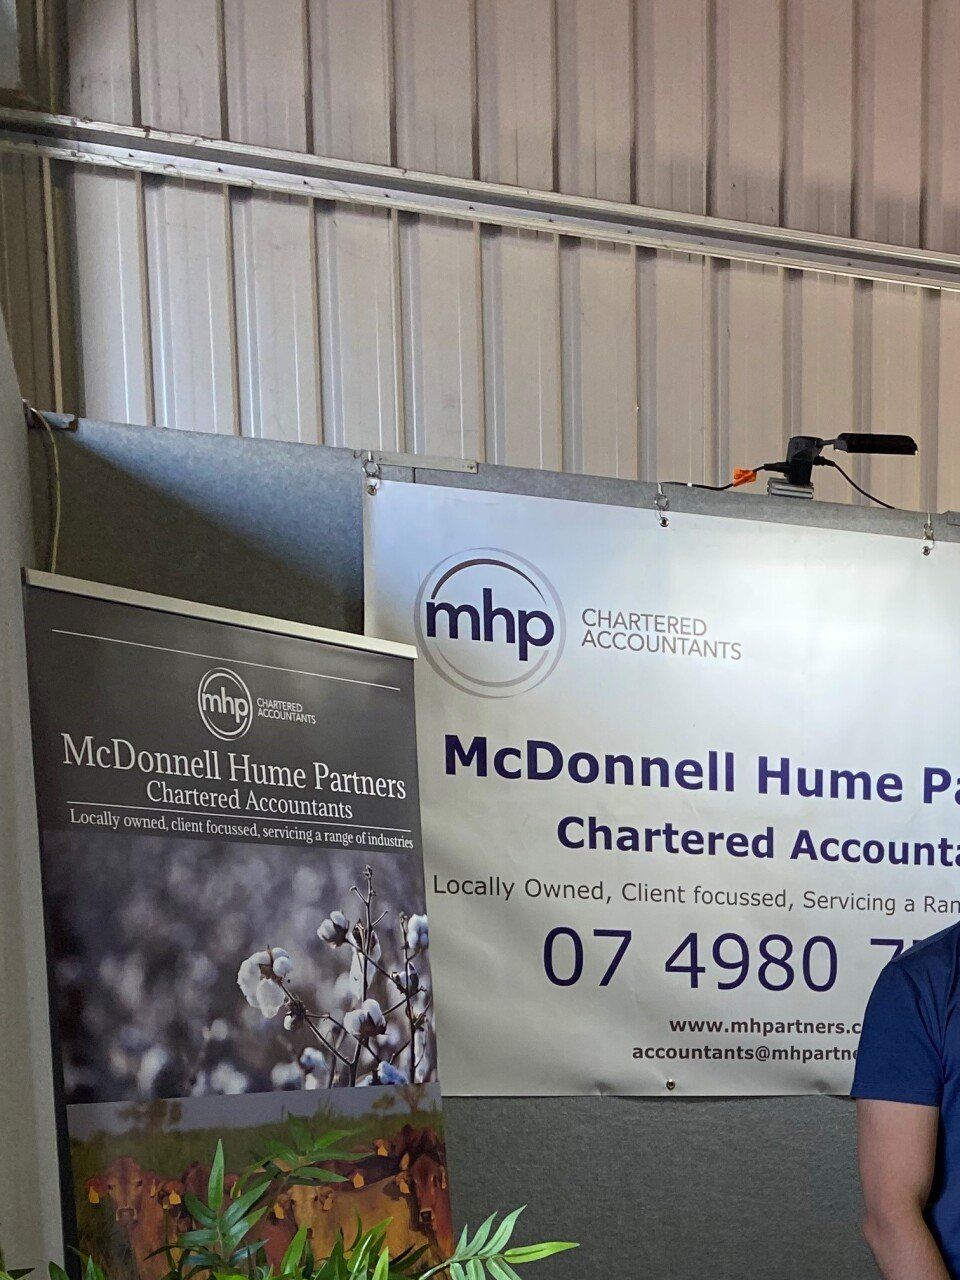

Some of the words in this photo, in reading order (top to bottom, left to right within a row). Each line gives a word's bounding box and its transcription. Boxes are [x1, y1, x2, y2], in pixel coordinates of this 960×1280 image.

[426, 588, 555, 661] mhp
[582, 608, 707, 636] CHARTERED
[581, 630, 742, 660] ACCOUNTANTS
[202, 687, 249, 723] mhp
[256, 697, 304, 712] CHARTERED
[257, 707, 317, 725] ACCOUNTANTS
[60, 732, 222, 781] McDonnell
[229, 752, 307, 789] Hume
[313, 762, 407, 799] Partners
[444, 734, 735, 792] McDonnell
[758, 756, 903, 803] Hume
[146, 779, 240, 811] Chartered
[245, 790, 353, 820] Accountants
[70, 808, 120, 830] Locally
[123, 814, 169, 831] owned,
[171, 818, 203, 833] client
[206, 819, 260, 839] focussed,
[263, 825, 313, 844] servicing
[315, 831, 323, 841] a
[325, 831, 354, 846] range
[356, 831, 366, 844] of
[367, 831, 414, 849] industries
[556, 816, 775, 859] Chartered
[433, 875, 515, 900] Locally
[525, 878, 612, 905] Owned,
[621, 882, 686, 904] Client
[693, 886, 794, 912] focussed,
[803, 890, 896, 916] Servicing
[904, 898, 915, 912] a
[542, 926, 633, 987] 07
[665, 932, 838, 993] 4980
[669, 1017, 862, 1037] www.mhpartners.c
[632, 1043, 858, 1063] accountants@mhpartn
